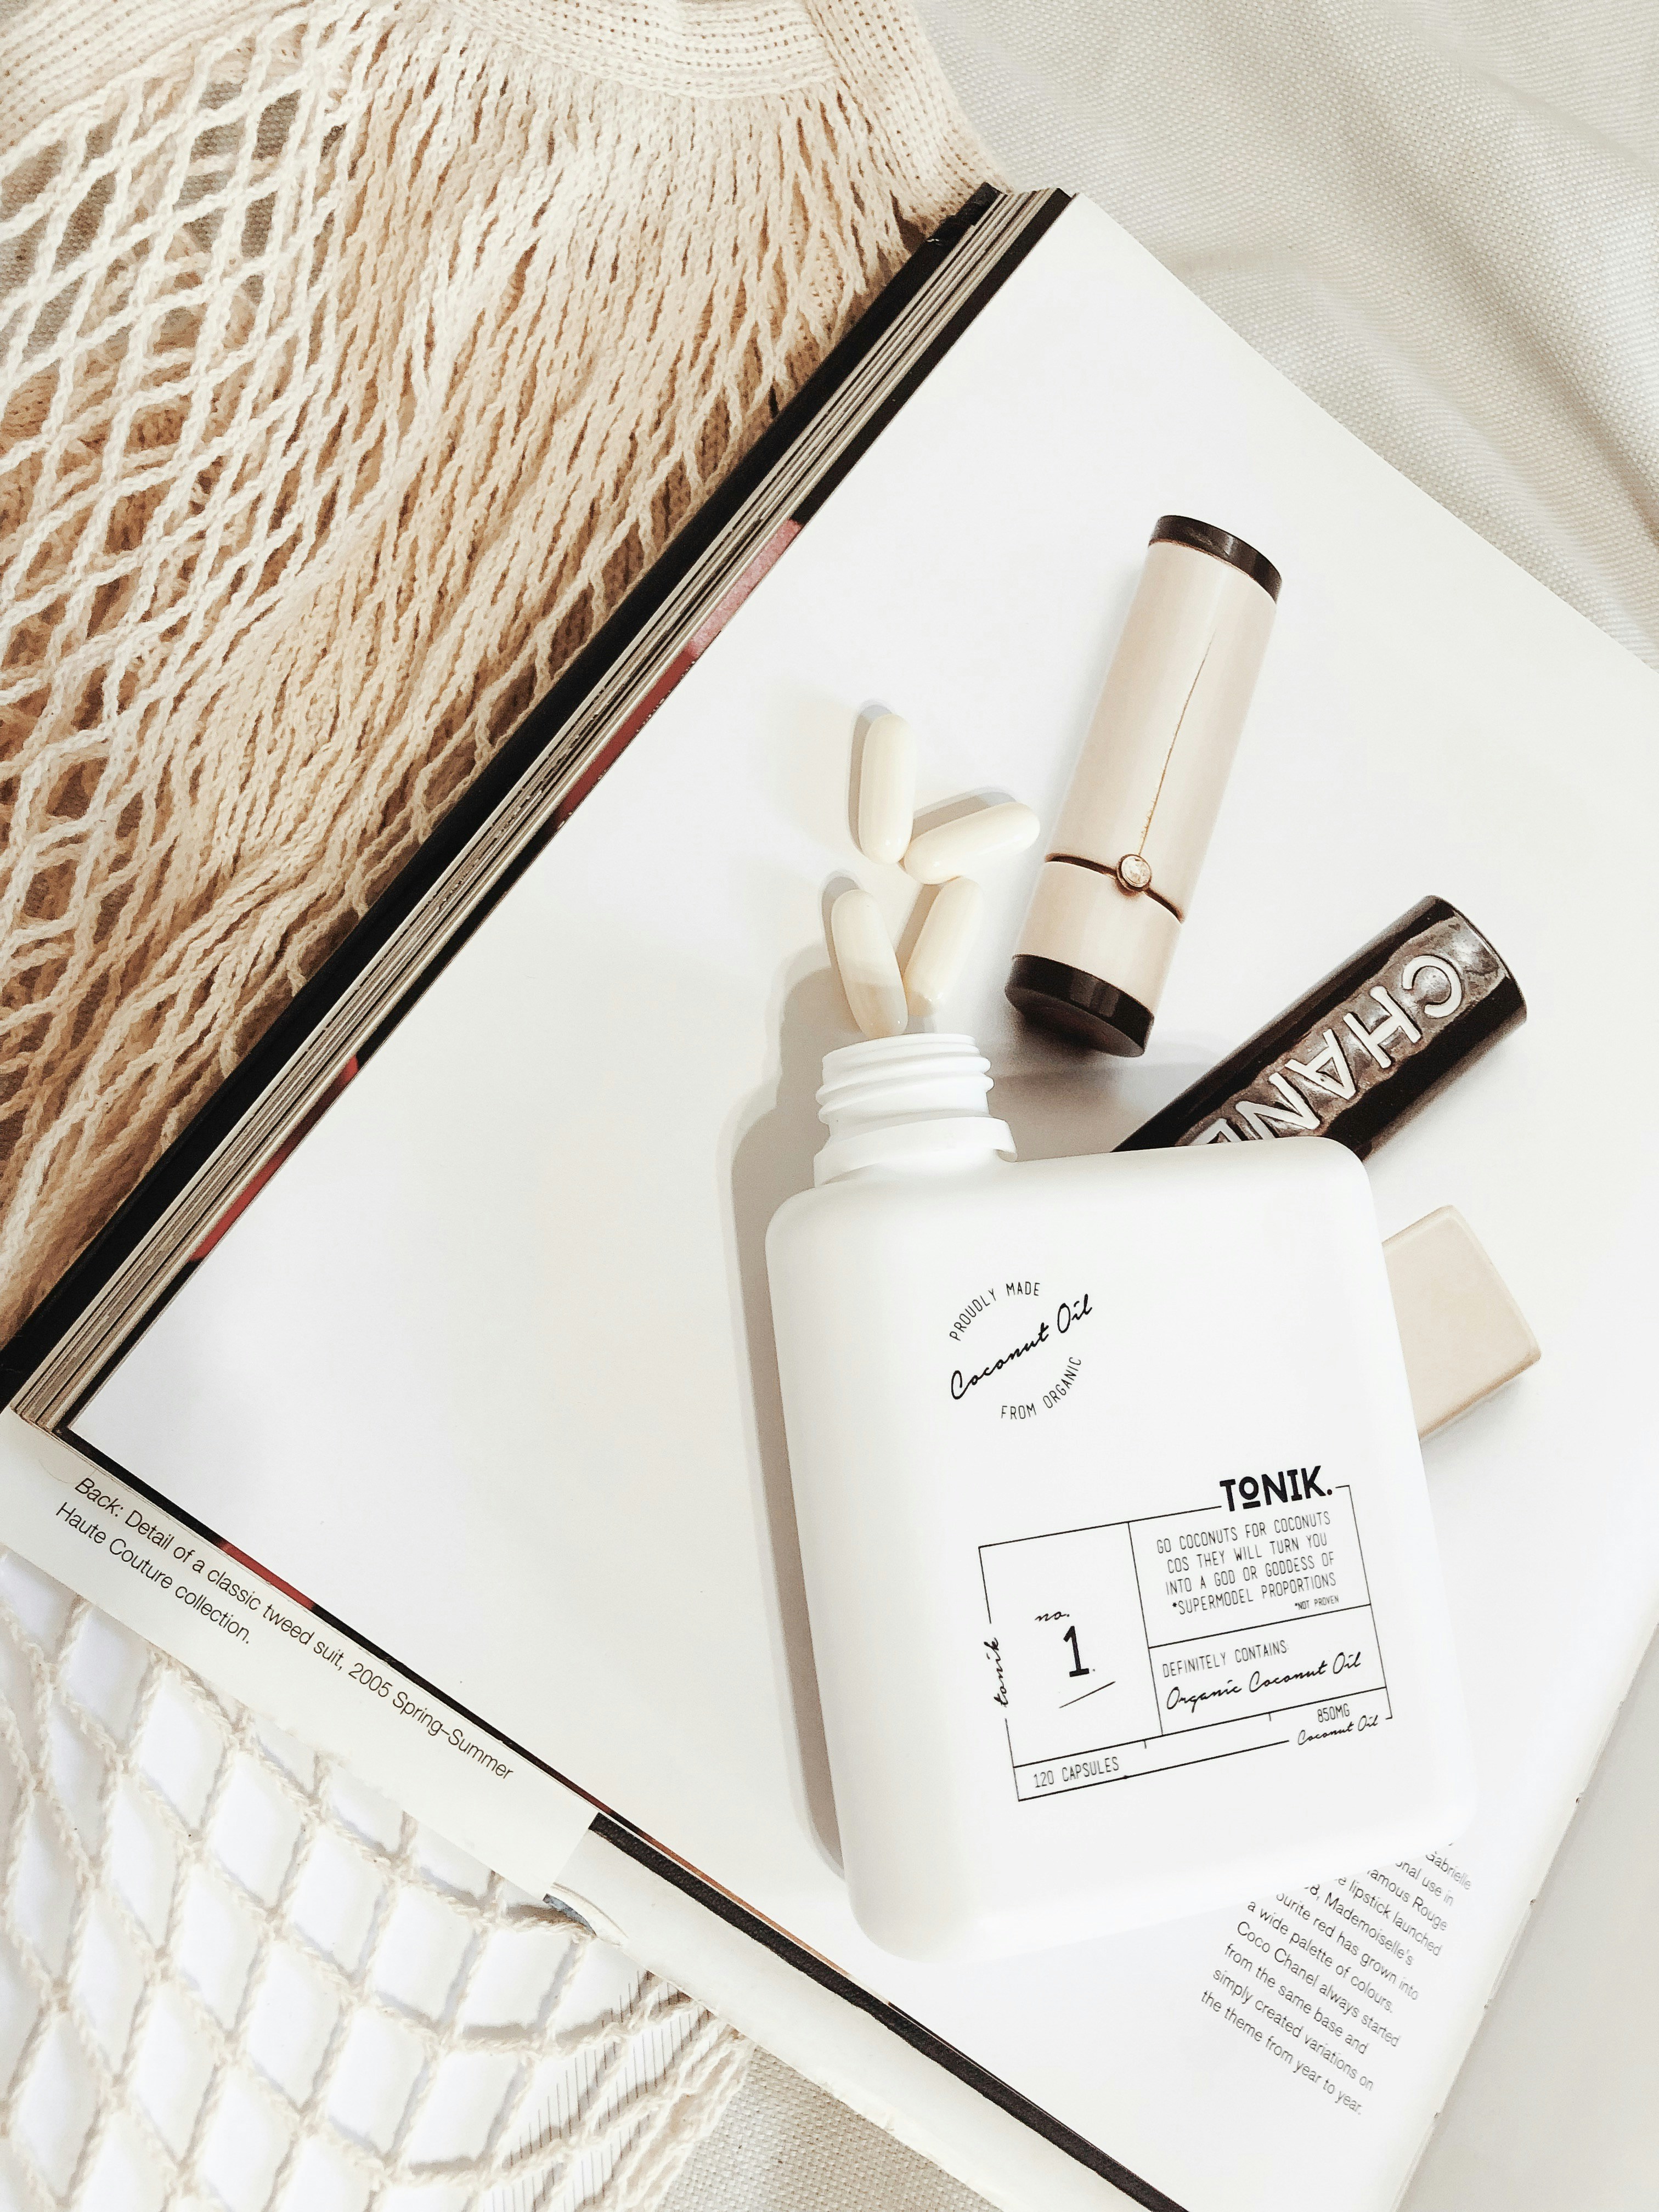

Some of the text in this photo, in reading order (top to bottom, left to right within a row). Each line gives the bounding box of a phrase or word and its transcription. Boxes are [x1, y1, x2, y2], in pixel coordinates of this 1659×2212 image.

[950, 1282, 1040, 1341] PROUDLY MADE
[951, 1294, 1092, 1400] Coconut Oil
[1001, 1357, 1081, 1420] FROM ORGANIC
[1157, 1511, 1330, 1554] GO COCONUTS FOR COCONUTS
[1167, 1533, 1327, 1573] COS THEY WILL TURN YOU
[56, 1502, 249, 1644] Haute Couture collection.
[75, 1477, 124, 1517] Back:
[124, 1510, 173, 1550] Detail
[173, 1545, 193, 1564] of
[191, 1560, 205, 1573] a
[207, 1569, 261, 1610] classic
[263, 1605, 314, 1645] tweed
[314, 1641, 344, 1671] suit,
[348, 1663, 393, 1697] 2005
[1165, 1552, 1334, 1595] INTO A GOD OR GODDESS OF
[1261, 1573, 1336, 1599] PROPORTIONS
[1314, 1595, 1339, 1607] PROVEN
[984, 1637, 1008, 1707] tonik
[1163, 1652, 1226, 1678] DEFINITELY
[1166, 1651, 1361, 1713] Organic Coconut Oil
[1297, 1714, 1379, 1746] Coconut Oil
[1317, 1703, 1350, 1723] 850MG
[1034, 1757, 1119, 1788] 120 CAPSULES
[1348, 1880, 1392, 1919] lipstick
[1392, 1911, 1443, 1956] launched
[1367, 1870, 1448, 1931] amous Rouge
[1422, 1877, 1442, 1896] use
[1443, 1889, 1453, 1906] in
[1248, 1901, 1392, 2013] a wide palette of colours.
[1313, 1918, 1337, 1938] red
[1337, 1931, 1359, 1955] has
[1360, 1954, 1397, 1984] grown
[1398, 1977, 1419, 2000] into
[1324, 1892, 1414, 1965] Mademoiselle's
[1224, 1943, 1370, 2055] from the same base and
[1238, 1921, 1401, 2047] Coco Chanel always started
[1201, 1990, 1362, 2115] the theme from year to year.
[1213, 1969, 1373, 2091] simply created variations on
